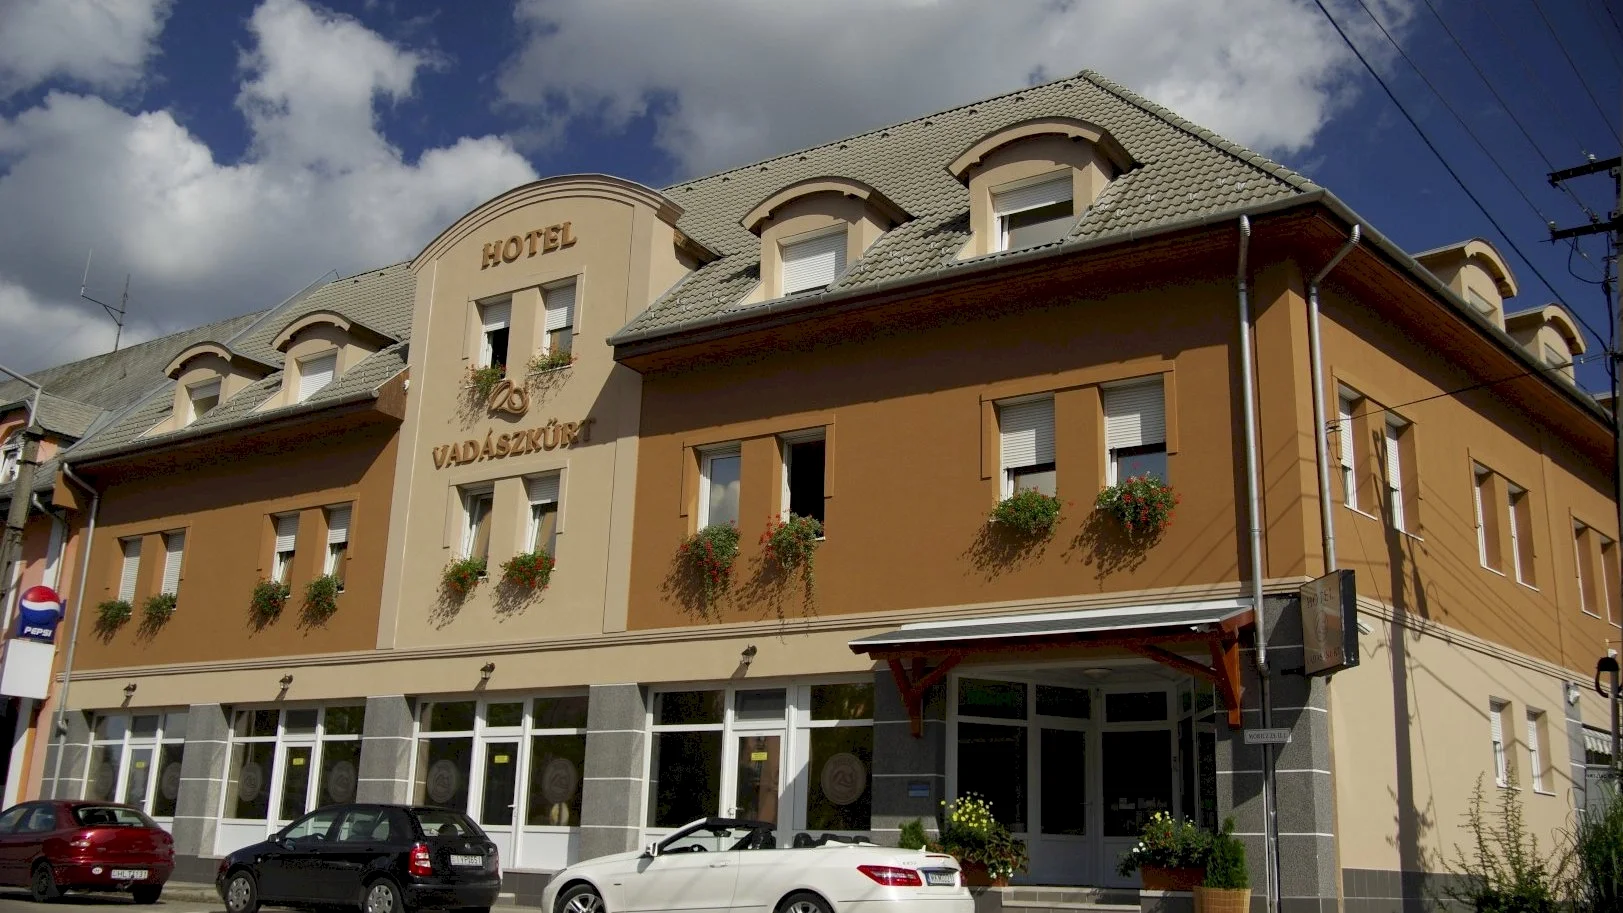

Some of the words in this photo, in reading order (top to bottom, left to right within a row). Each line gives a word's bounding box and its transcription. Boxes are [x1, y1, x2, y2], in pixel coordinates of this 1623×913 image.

[481, 221, 578, 270] HOTEL
[1306, 587, 1335, 609] HOTEL
[24, 626, 52, 637] PEPSI
